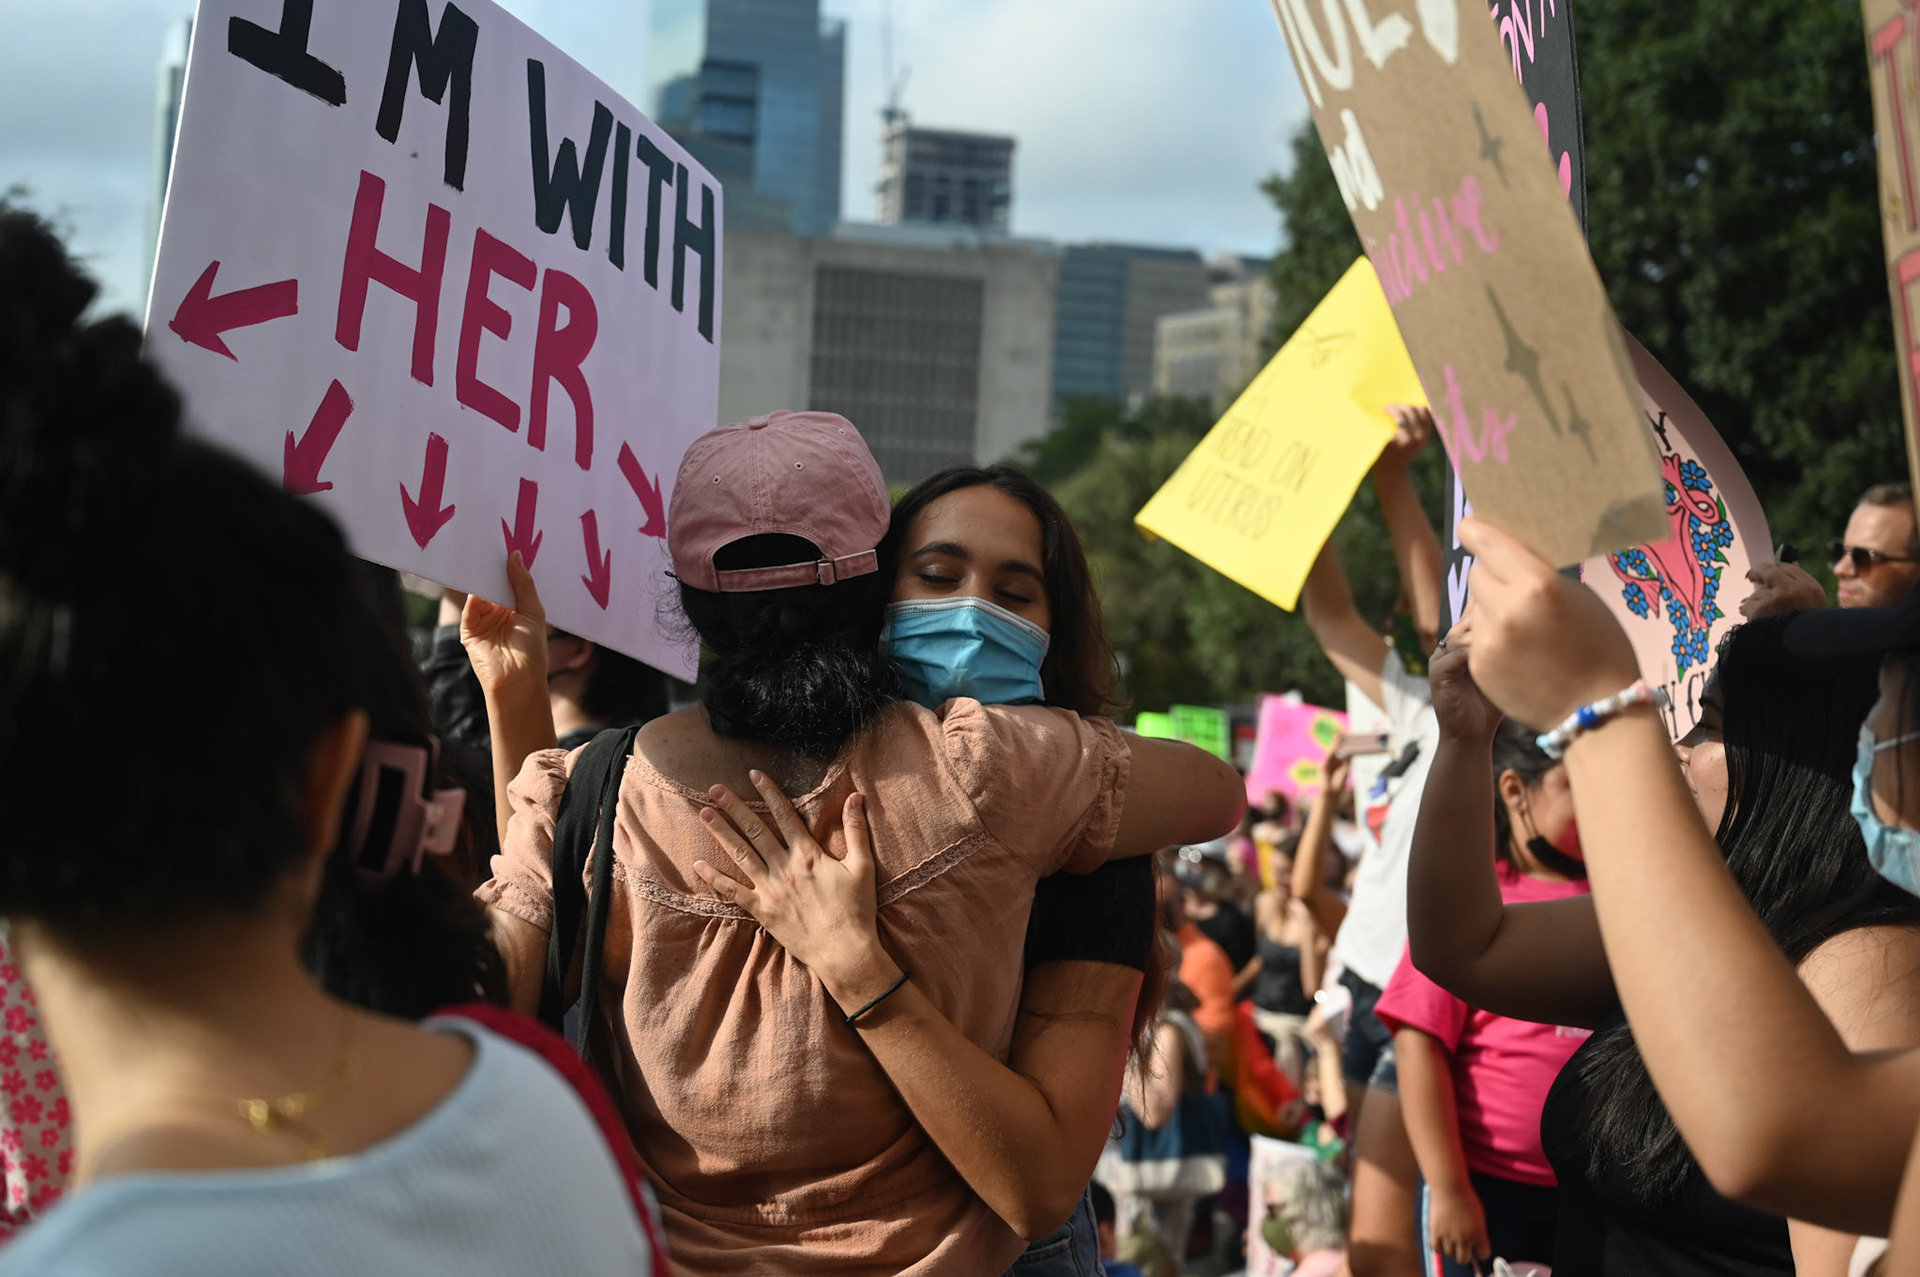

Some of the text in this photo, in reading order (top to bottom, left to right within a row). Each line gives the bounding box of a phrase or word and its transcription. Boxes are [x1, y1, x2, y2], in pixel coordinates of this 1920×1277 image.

[335, 170, 599, 470] HER
[527, 58, 714, 343] WITH
[1270, 438, 1321, 492] ON
